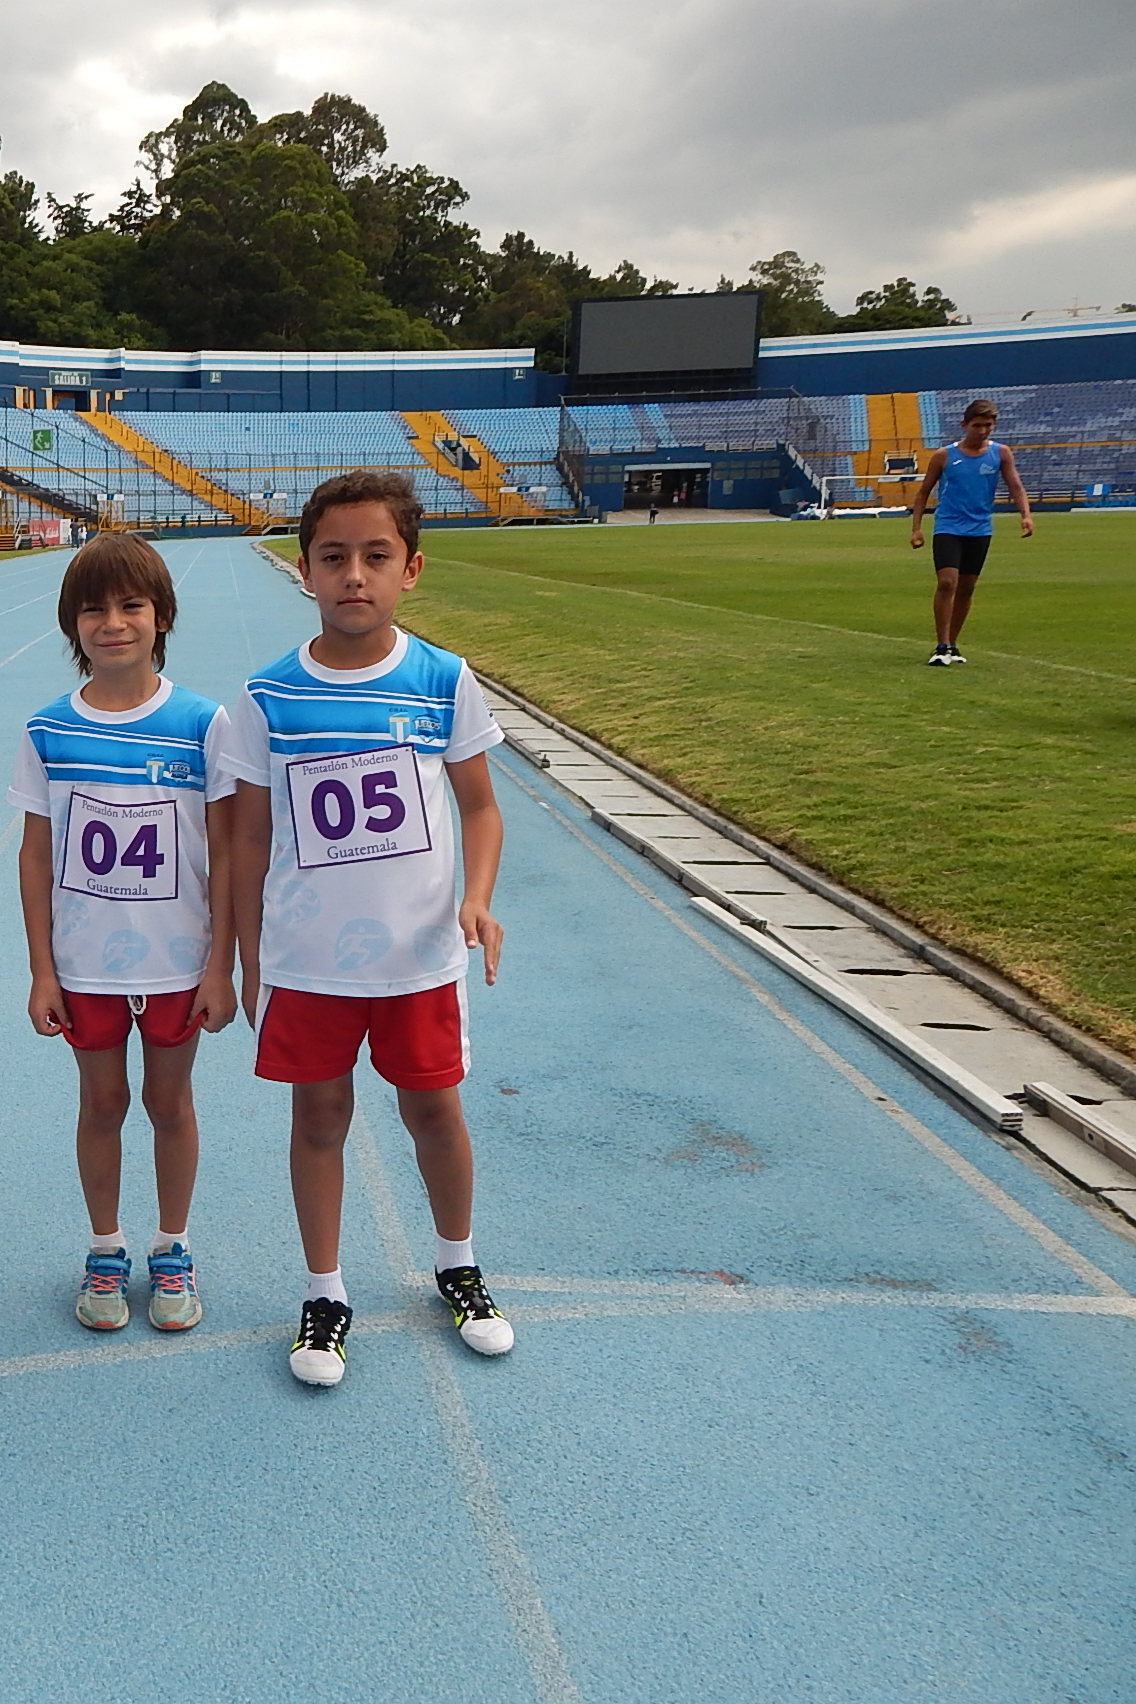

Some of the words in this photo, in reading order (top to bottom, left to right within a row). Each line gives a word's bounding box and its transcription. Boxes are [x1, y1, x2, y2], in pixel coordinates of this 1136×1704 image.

[54, 374, 80, 385] SALIDA
[302, 760, 349, 776] Pentatlón
[351, 752, 399, 769] Moderno
[81, 799, 119, 819] Pentatlón
[121, 808, 164, 819] Moderno
[310, 770, 407, 841] 05
[81, 819, 165, 879] 04
[326, 837, 399, 860] Guatemala
[86, 878, 149, 896] Guatemala
